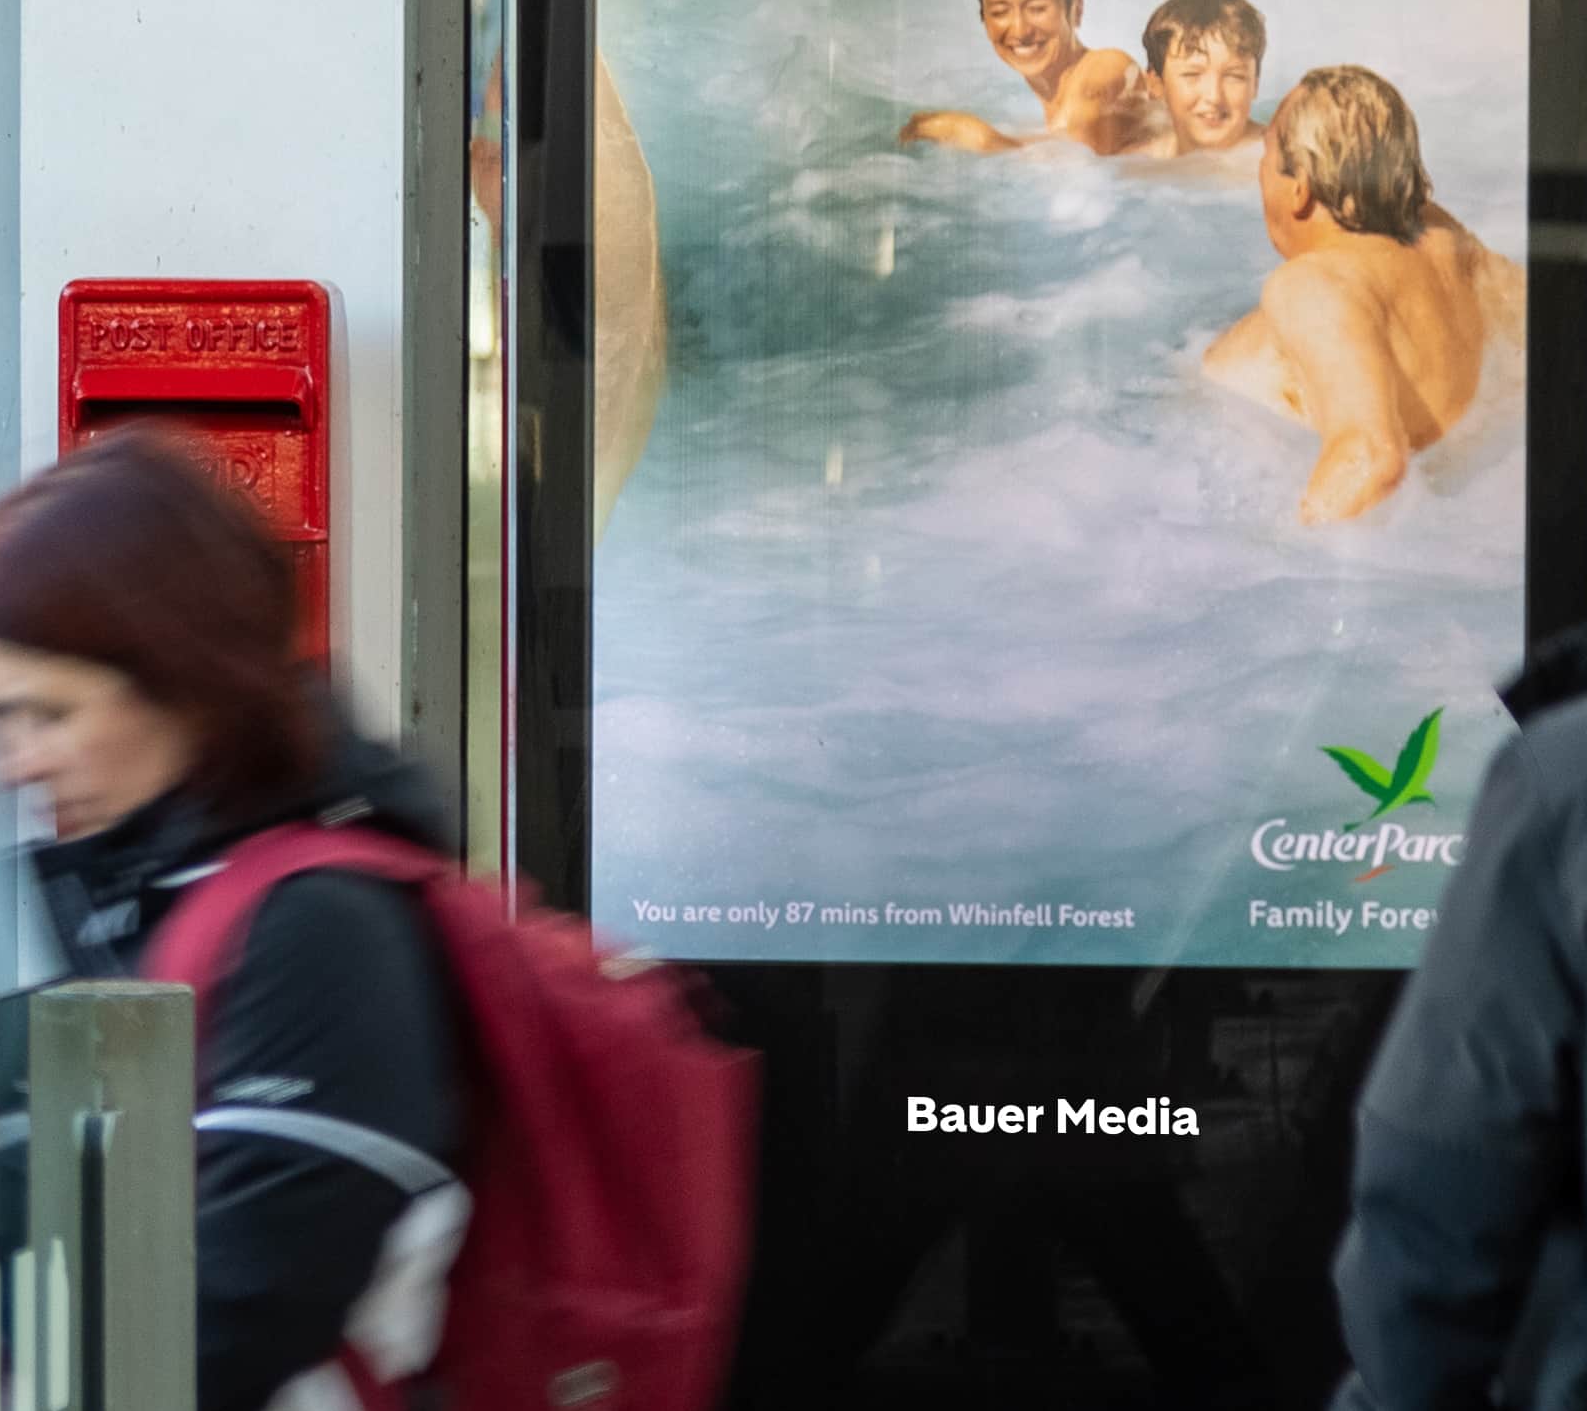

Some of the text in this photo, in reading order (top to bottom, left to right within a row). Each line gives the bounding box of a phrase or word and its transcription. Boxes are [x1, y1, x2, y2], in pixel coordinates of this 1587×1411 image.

[90, 317, 300, 353] POST OFFICE
[1250, 817, 1467, 872] CenterParc
[632, 899, 1136, 930] You are only 87 mins from Whinfell Forest
[1249, 899, 1438, 936] Family Fore
[906, 1095, 1200, 1136] Bauer Media
